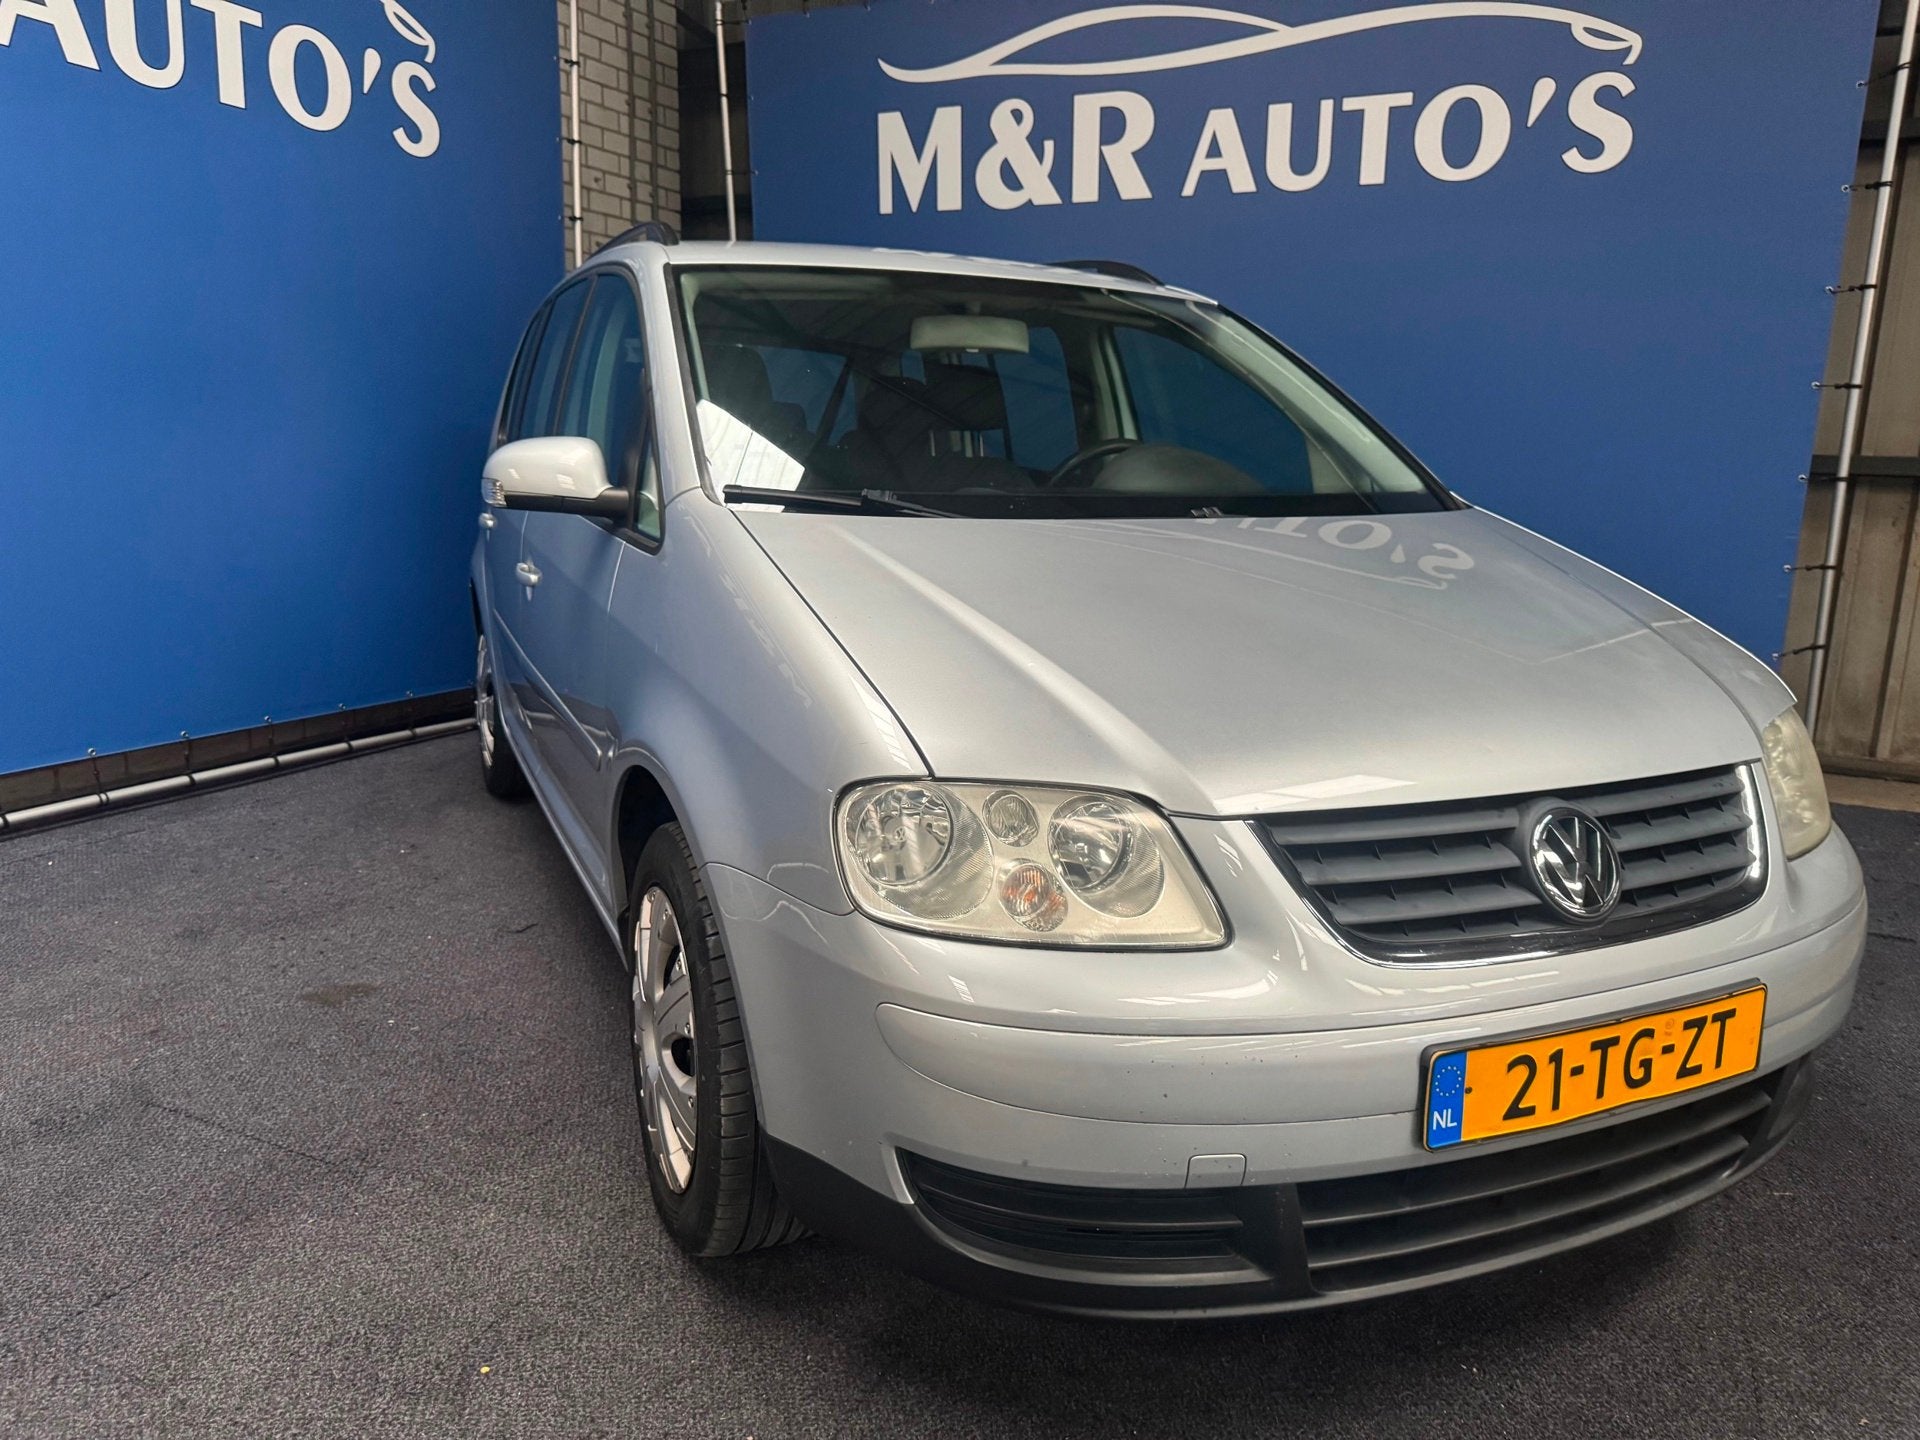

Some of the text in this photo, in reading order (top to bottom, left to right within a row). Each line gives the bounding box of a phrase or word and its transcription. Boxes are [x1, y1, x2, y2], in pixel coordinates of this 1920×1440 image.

[877, 71, 1636, 215] M&R AUTO'S
[1432, 1108, 1458, 1130] NL
[1502, 1008, 1737, 1121] 21-TG-ZT
